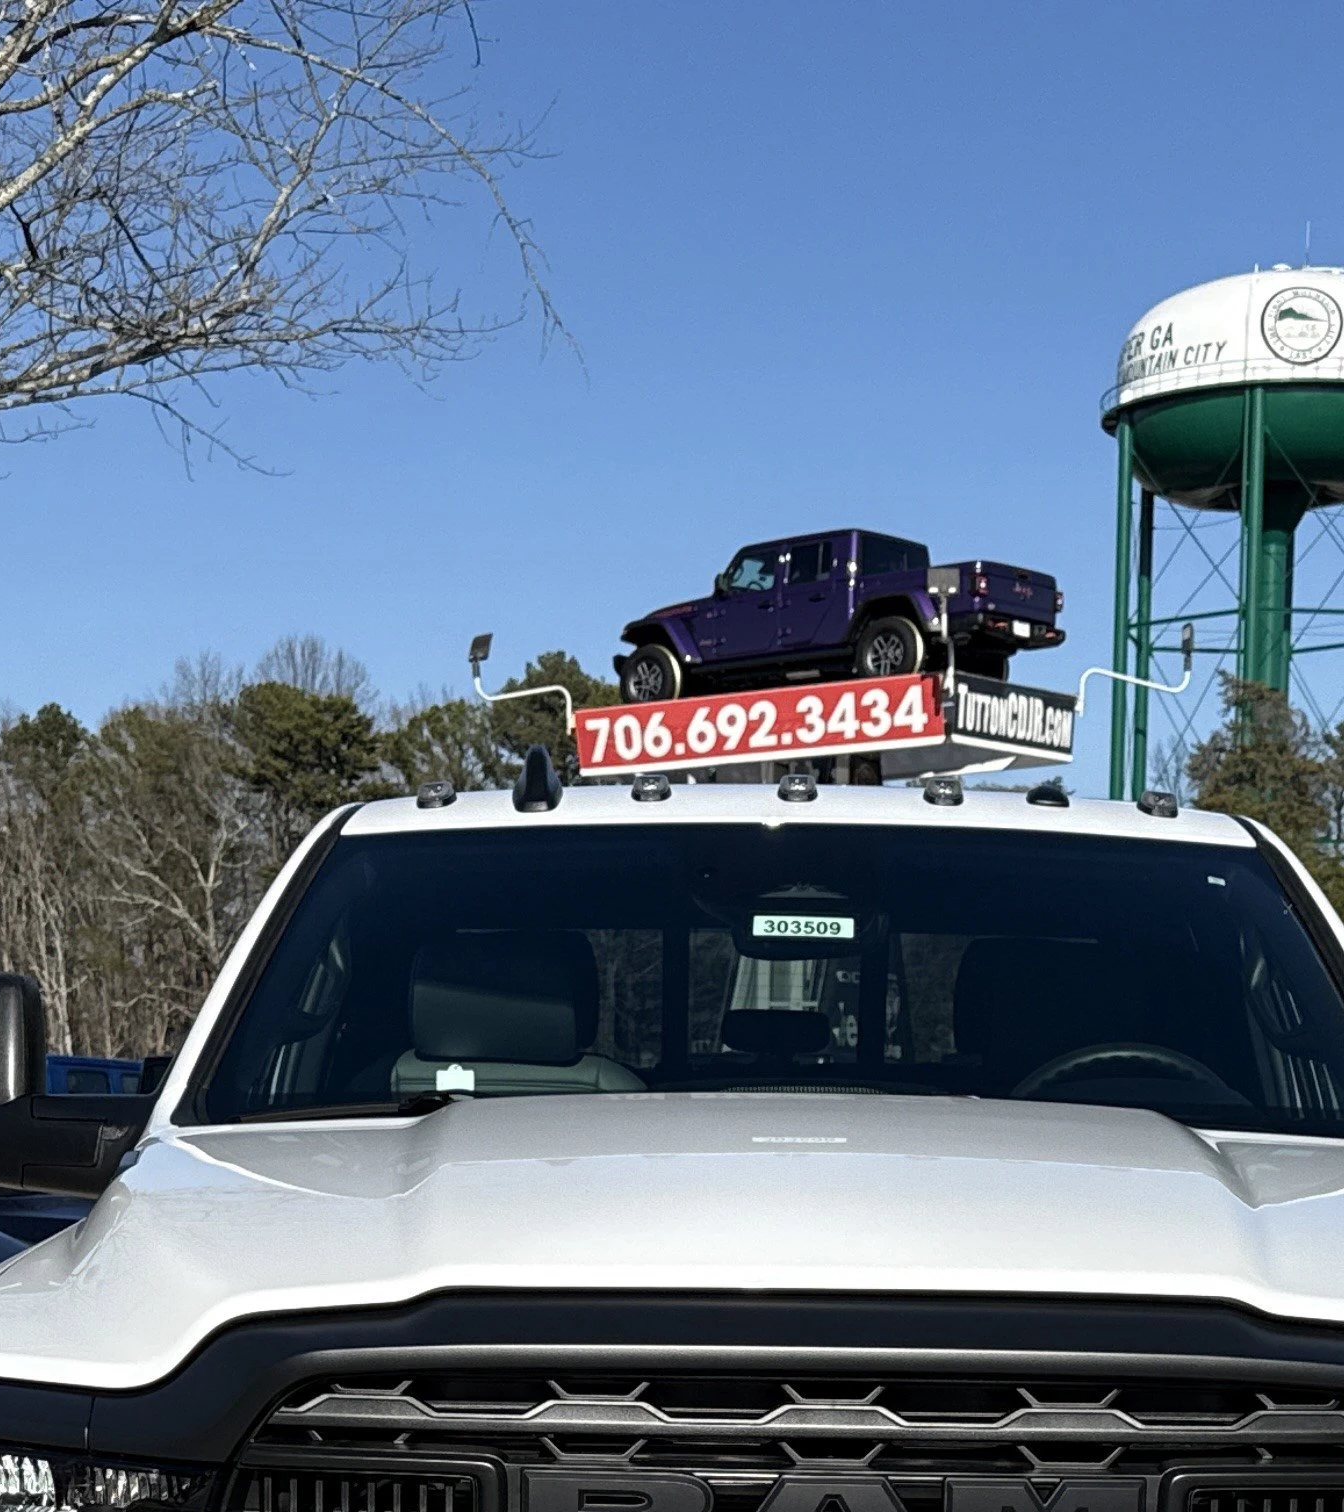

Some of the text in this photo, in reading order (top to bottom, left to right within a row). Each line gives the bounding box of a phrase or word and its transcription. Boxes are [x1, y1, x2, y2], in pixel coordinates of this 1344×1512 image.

[1150, 322, 1174, 351] GA
[1184, 340, 1227, 366] CITY
[585, 684, 928, 764] 706.692.3434
[763, 919, 842, 936] 303509
